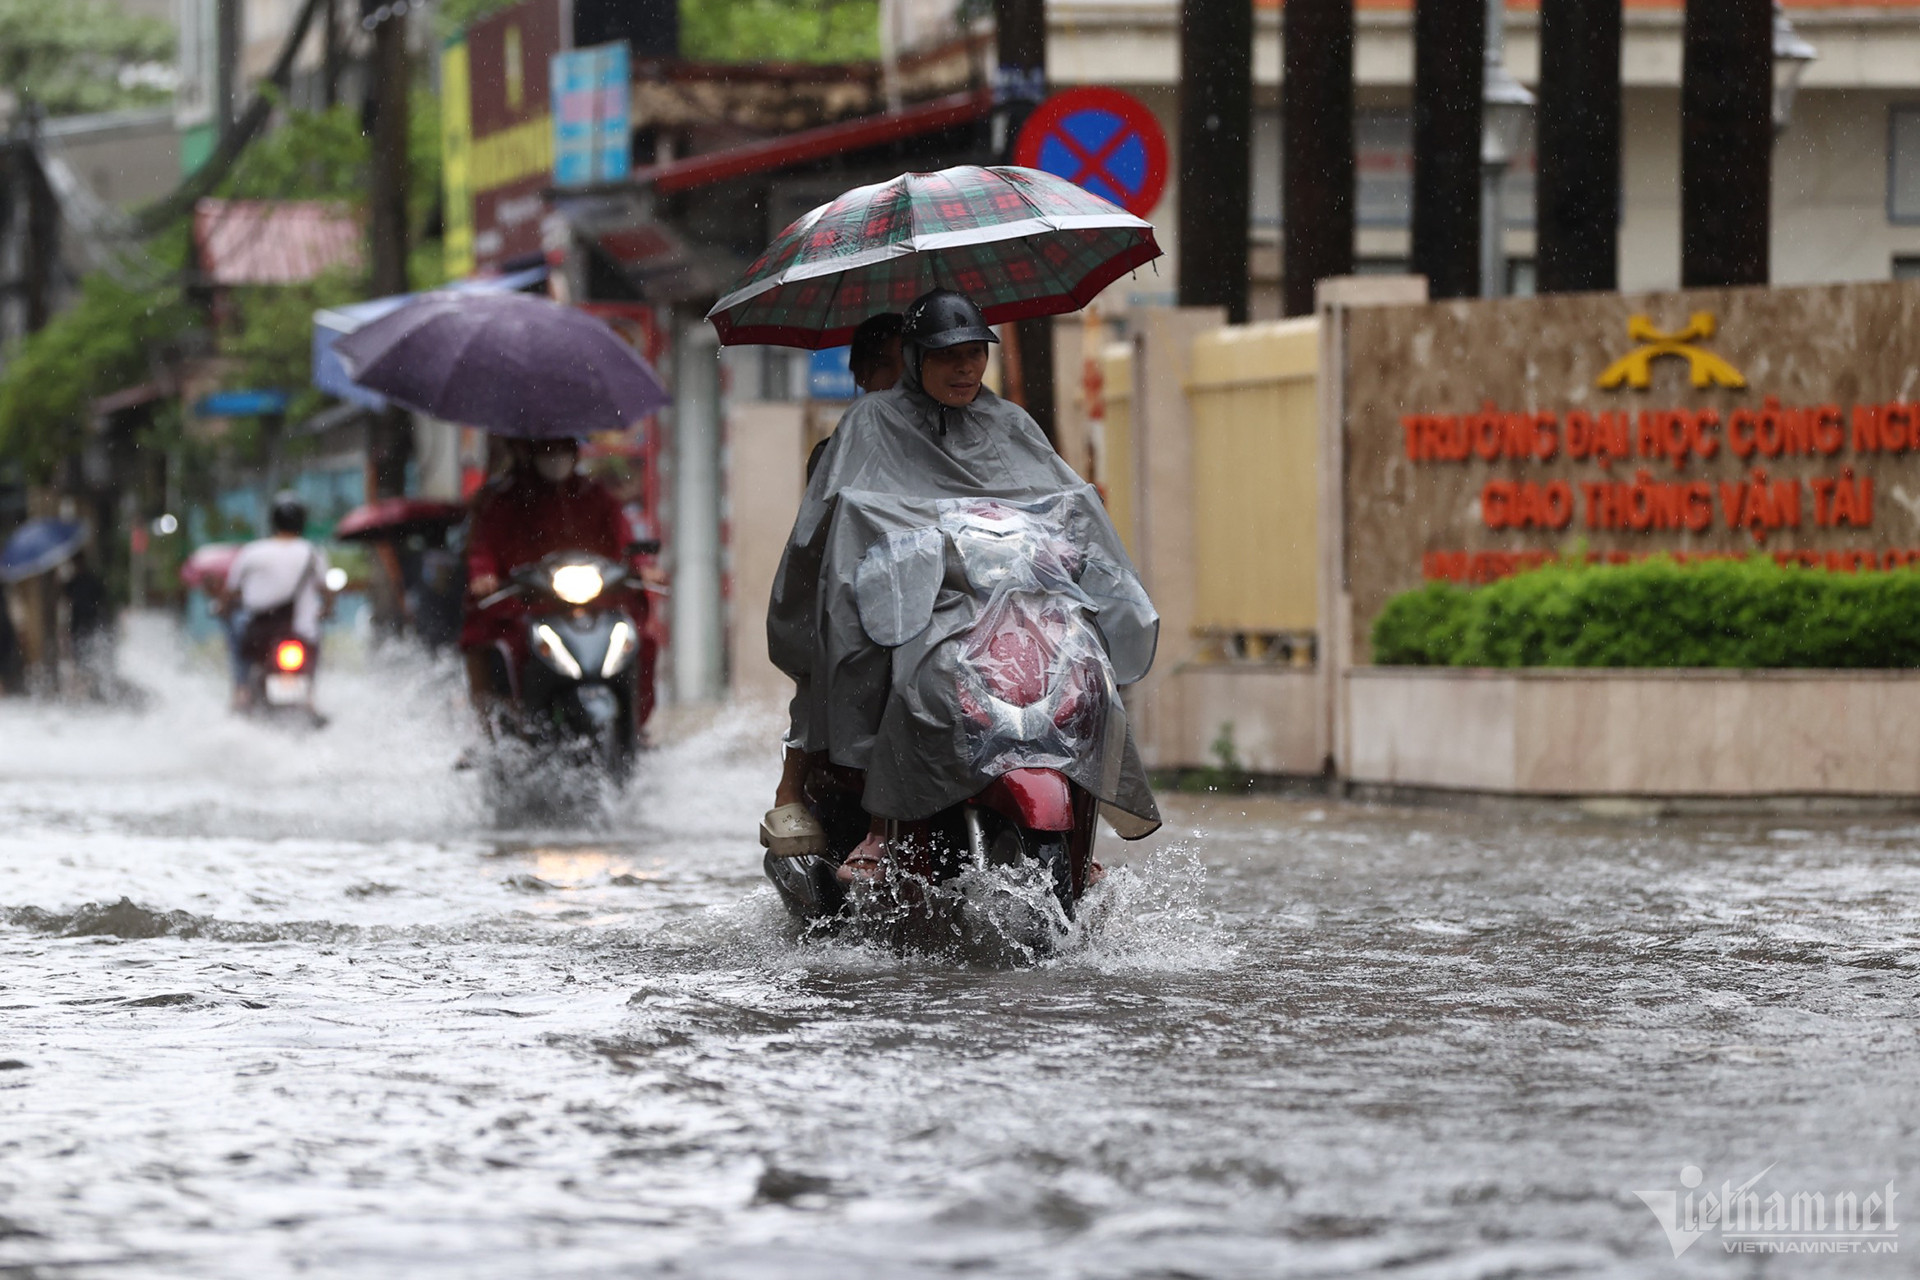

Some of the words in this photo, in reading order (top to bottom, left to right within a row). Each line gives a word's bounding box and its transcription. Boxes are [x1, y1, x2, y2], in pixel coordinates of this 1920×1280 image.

[1636, 408, 1719, 470] HỌC
[1727, 396, 1845, 456] CÔNG
[1481, 479, 1574, 529] GIAO
[1580, 469, 1713, 530] THÔNG
[1718, 467, 1801, 541] VẬN
[1810, 465, 1873, 526] TẢI
